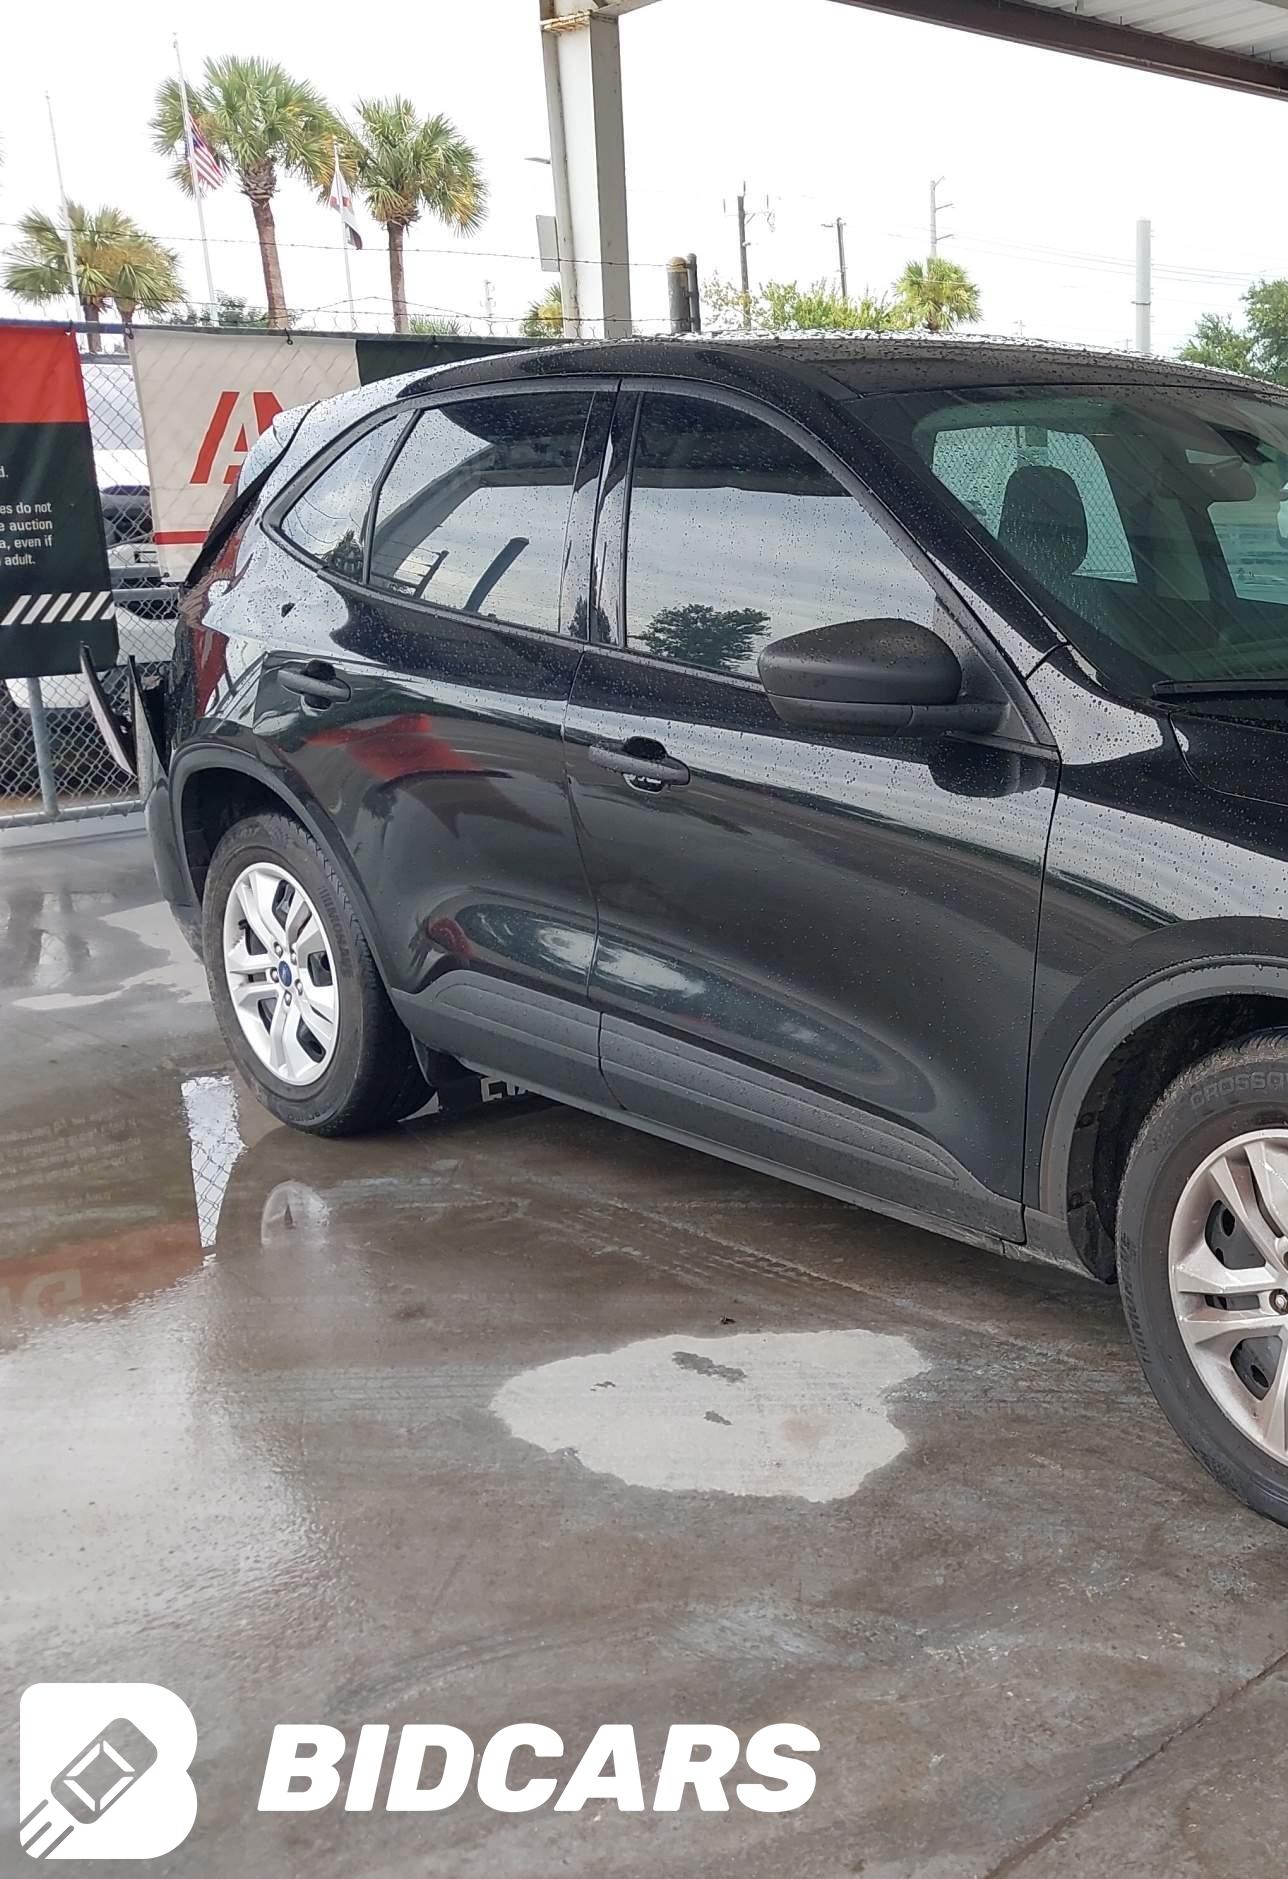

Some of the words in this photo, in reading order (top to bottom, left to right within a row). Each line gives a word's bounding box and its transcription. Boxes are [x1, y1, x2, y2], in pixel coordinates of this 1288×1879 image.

[16, 502, 32, 514] do
[34, 502, 52, 513] not
[9, 519, 53, 532] auction
[14, 538, 42, 549] even
[44, 534, 53, 547] if
[4, 553, 36, 567] adult.
